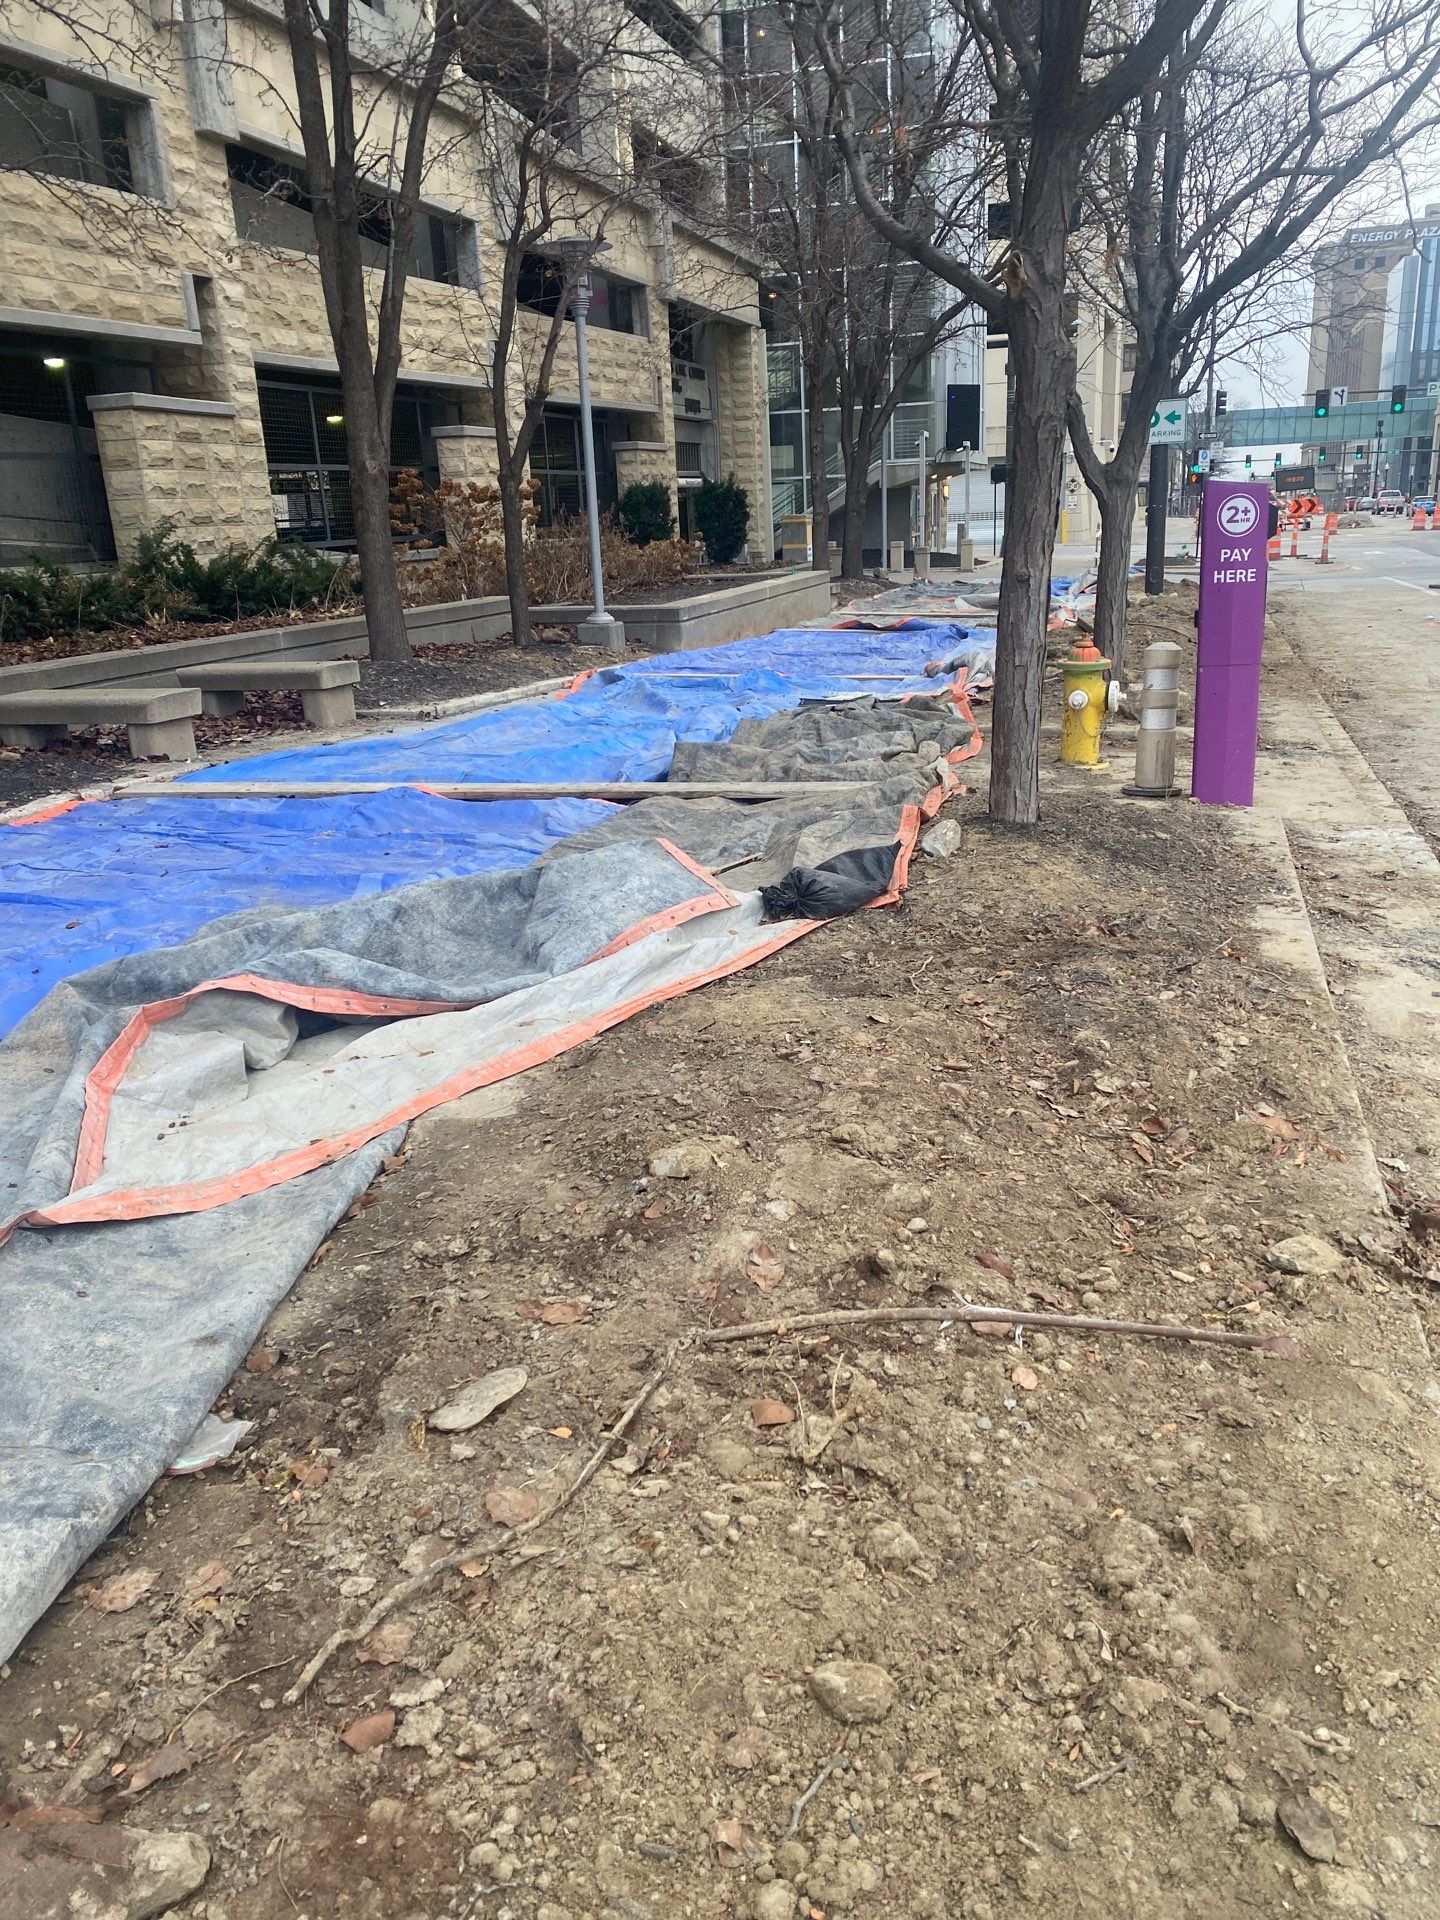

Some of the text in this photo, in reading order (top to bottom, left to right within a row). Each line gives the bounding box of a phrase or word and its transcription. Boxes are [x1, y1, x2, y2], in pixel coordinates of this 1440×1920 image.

[1350, 226, 1440, 243] ENERGY PLAZ
[1151, 430, 1182, 438] ARKING
[1220, 548, 1252, 562] PAY
[1213, 568, 1257, 583] HERE
